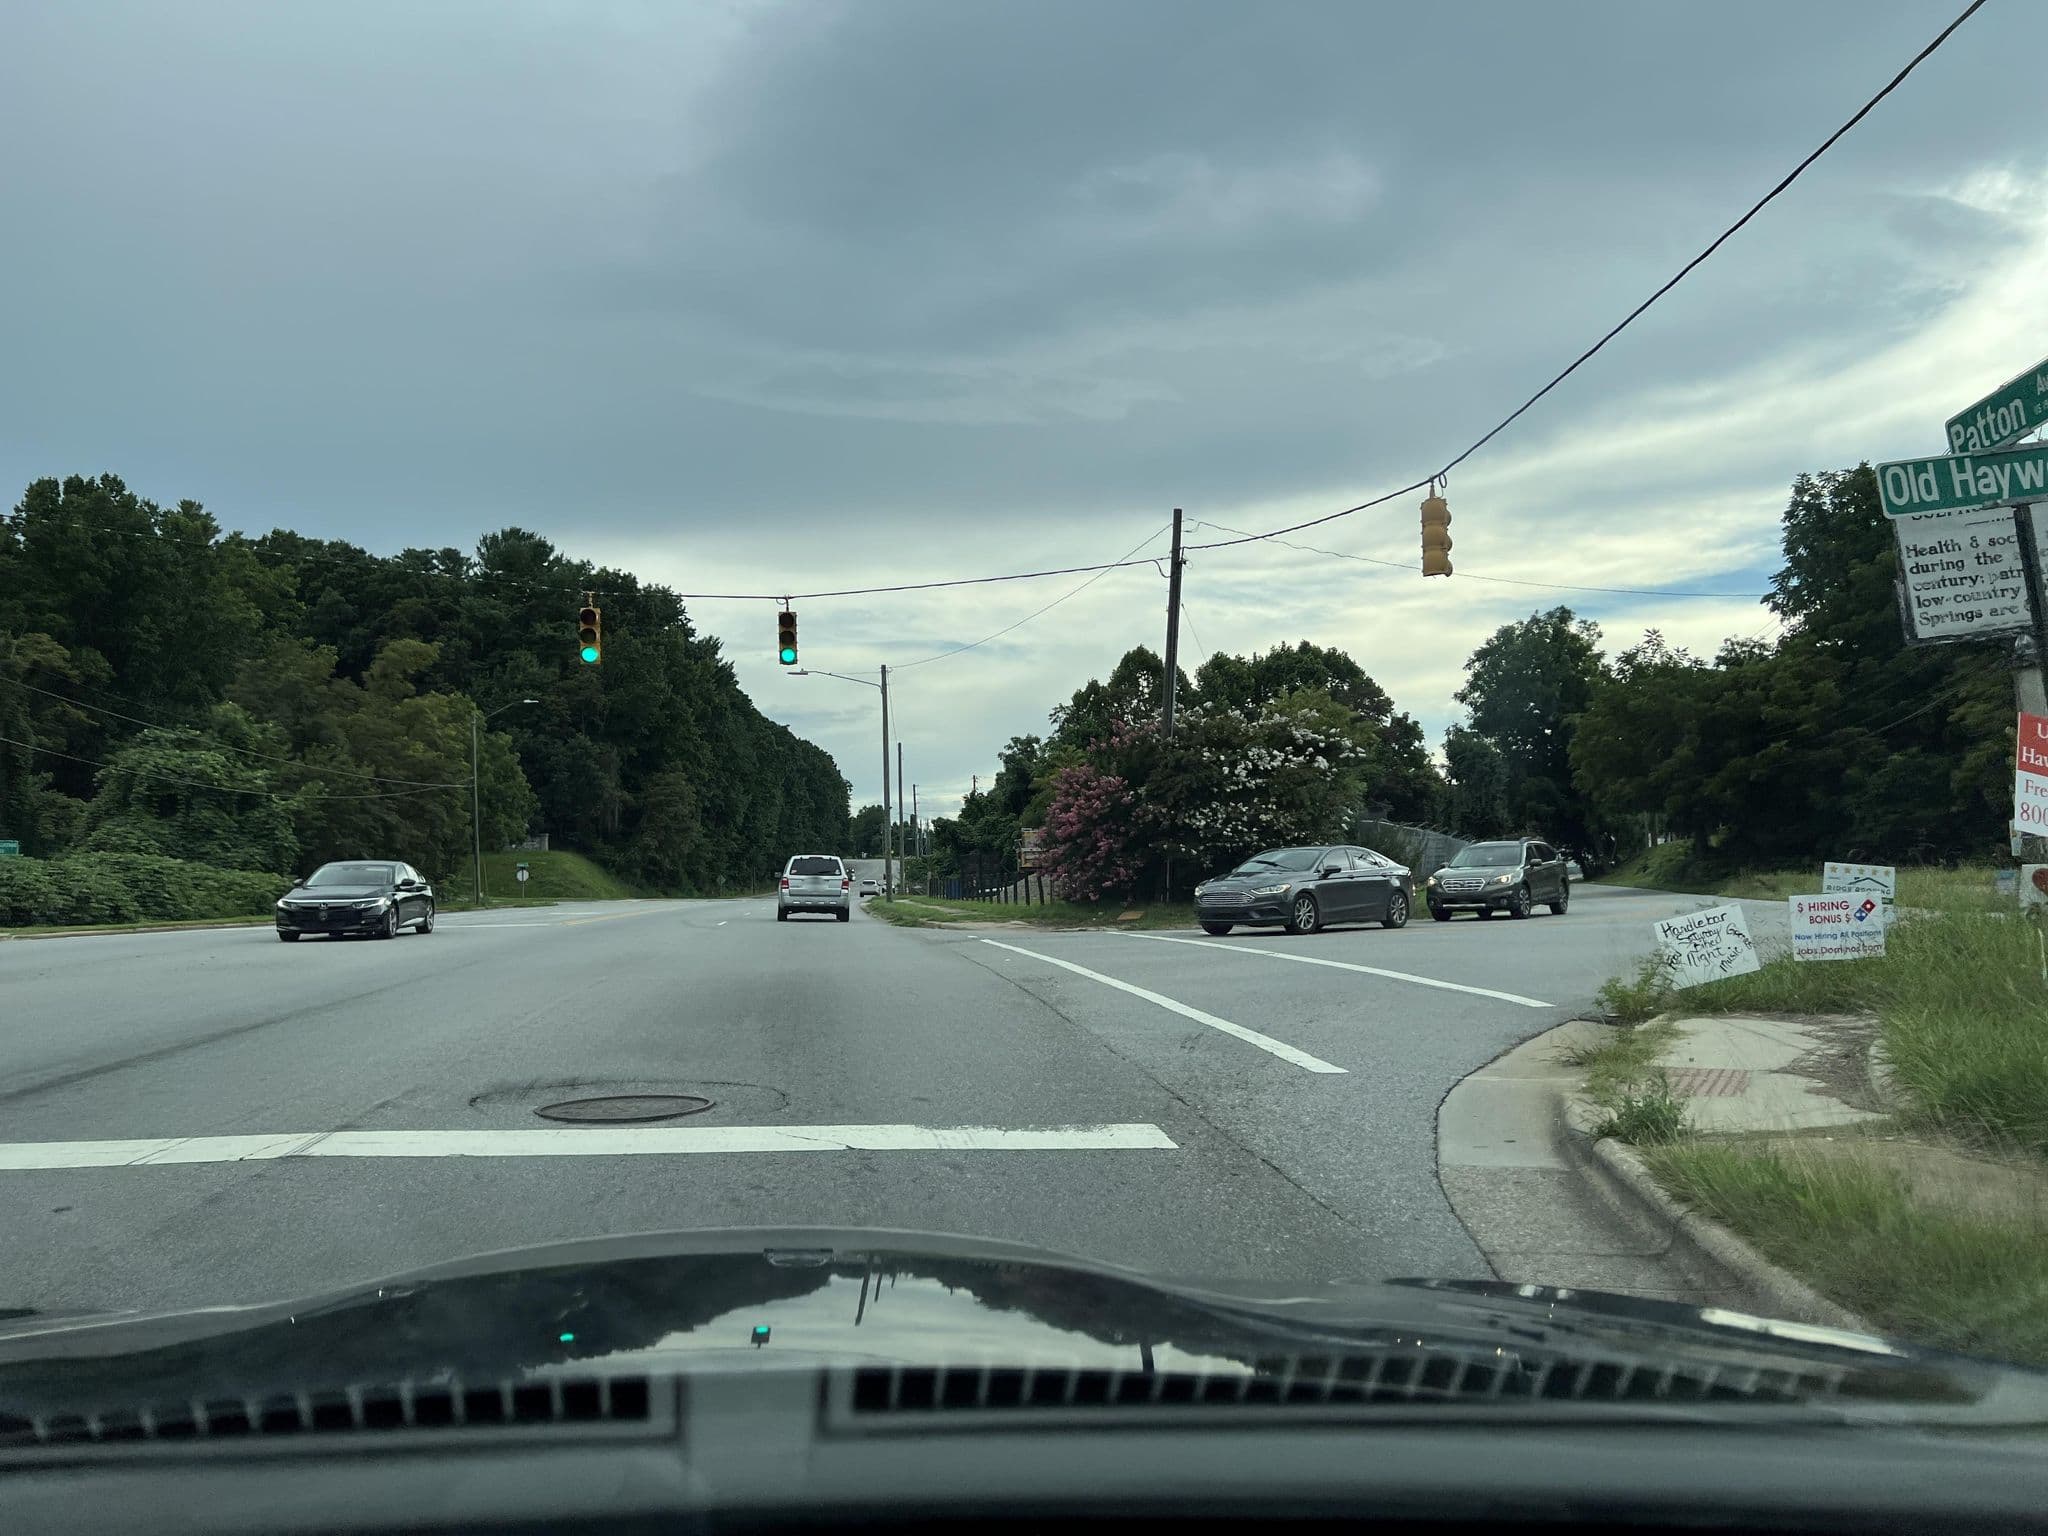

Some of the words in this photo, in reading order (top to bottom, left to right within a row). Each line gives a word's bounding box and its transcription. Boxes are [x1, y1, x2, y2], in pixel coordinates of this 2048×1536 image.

[1951, 398, 2026, 454] Patton
[1885, 462, 1940, 506] Old
[1949, 458, 2048, 500] Hayw
[1906, 537, 1962, 558] Health
[1969, 536, 1980, 549] &
[1988, 534, 2018, 547] soc
[1909, 559, 1966, 575] during
[1975, 551, 2004, 566] the
[1918, 608, 1984, 628] Springs
[1989, 605, 2020, 617] are
[1797, 902, 1804, 914] $
[1808, 900, 1850, 912] HIRING
[1809, 914, 1842, 925] BONUS
[1845, 913, 1852, 924] $
[1661, 912, 1728, 939] Handlebar
[1814, 932, 1838, 941] Hiring
[1719, 946, 1743, 974] Music
